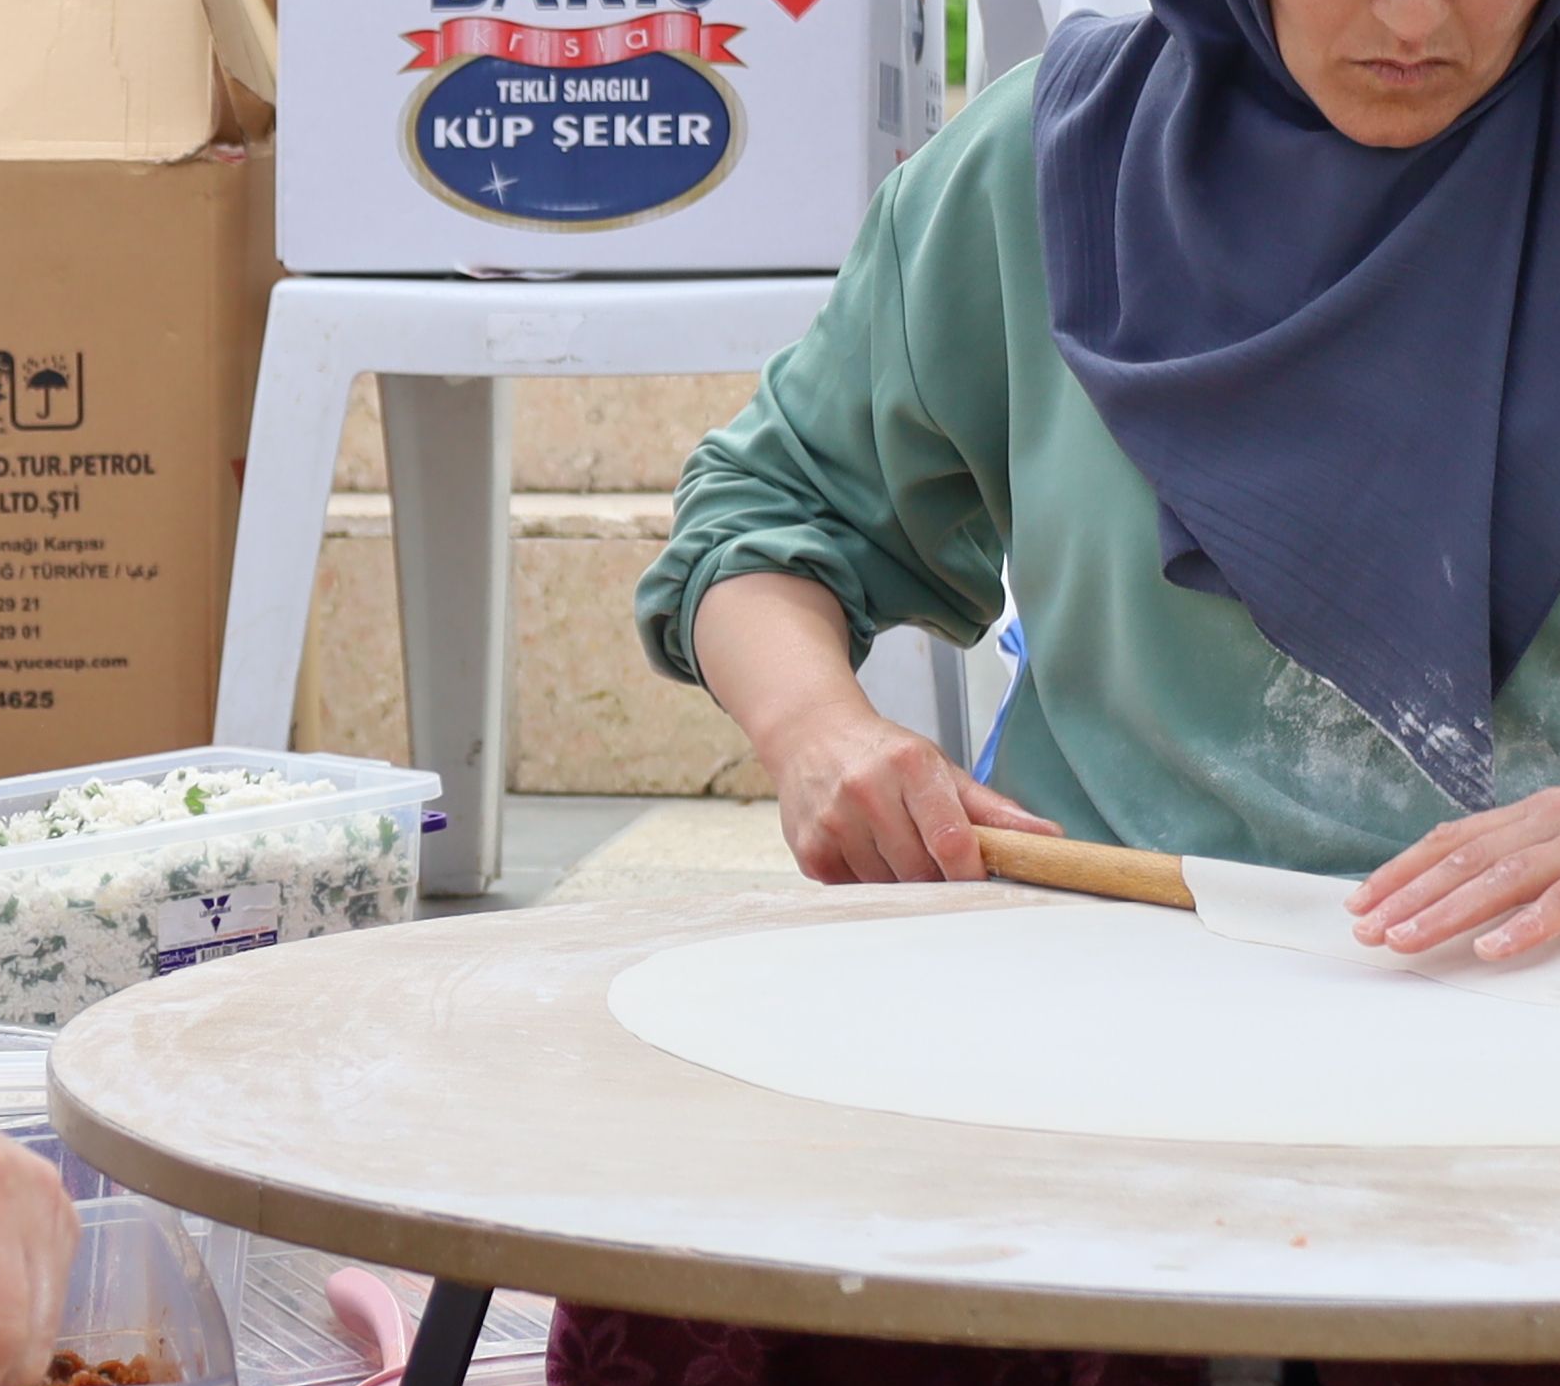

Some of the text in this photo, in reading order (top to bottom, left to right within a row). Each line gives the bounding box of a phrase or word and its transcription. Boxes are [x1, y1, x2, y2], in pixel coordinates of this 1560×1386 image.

[496, 73, 650, 104] TEKLİ SARGILI
[432, 108, 712, 153] KÜP ŞEKER
[31, 561, 108, 579] TÜRKİYE
[21, 597, 40, 611] 21
[22, 625, 41, 640] 01
